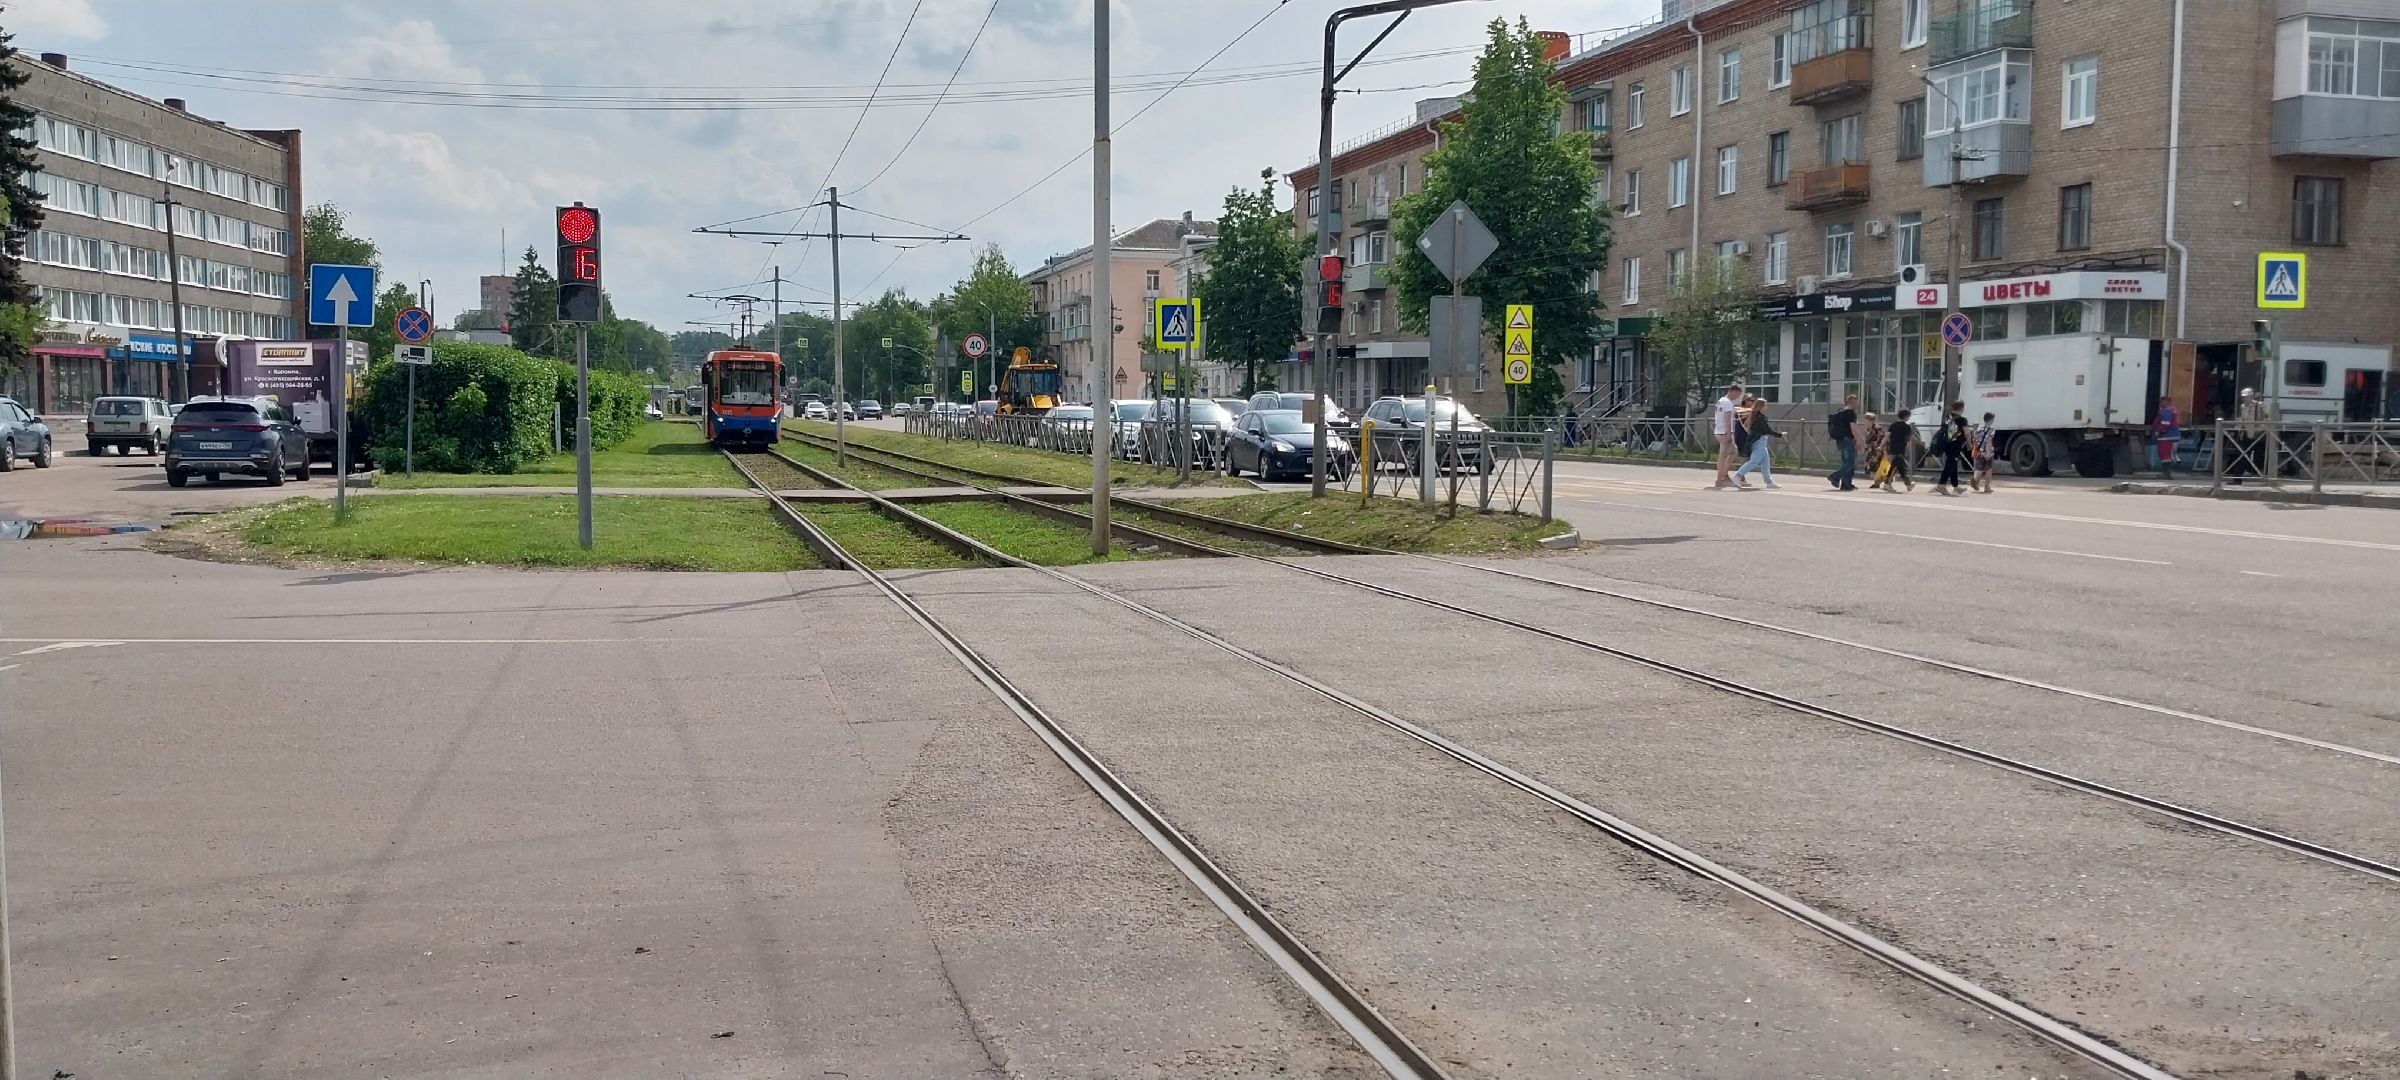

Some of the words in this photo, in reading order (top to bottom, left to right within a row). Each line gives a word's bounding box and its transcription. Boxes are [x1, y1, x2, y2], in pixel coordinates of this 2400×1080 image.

[576, 250, 596, 280] 16
[1328, 284, 1341, 306] 16
[1919, 291, 1936, 301] 24
[1983, 280, 2051, 301] ЦВЕТЫ
[1824, 294, 1853, 311] iShop
[969, 340, 982, 350] 40
[1513, 366, 1524, 375] 40
